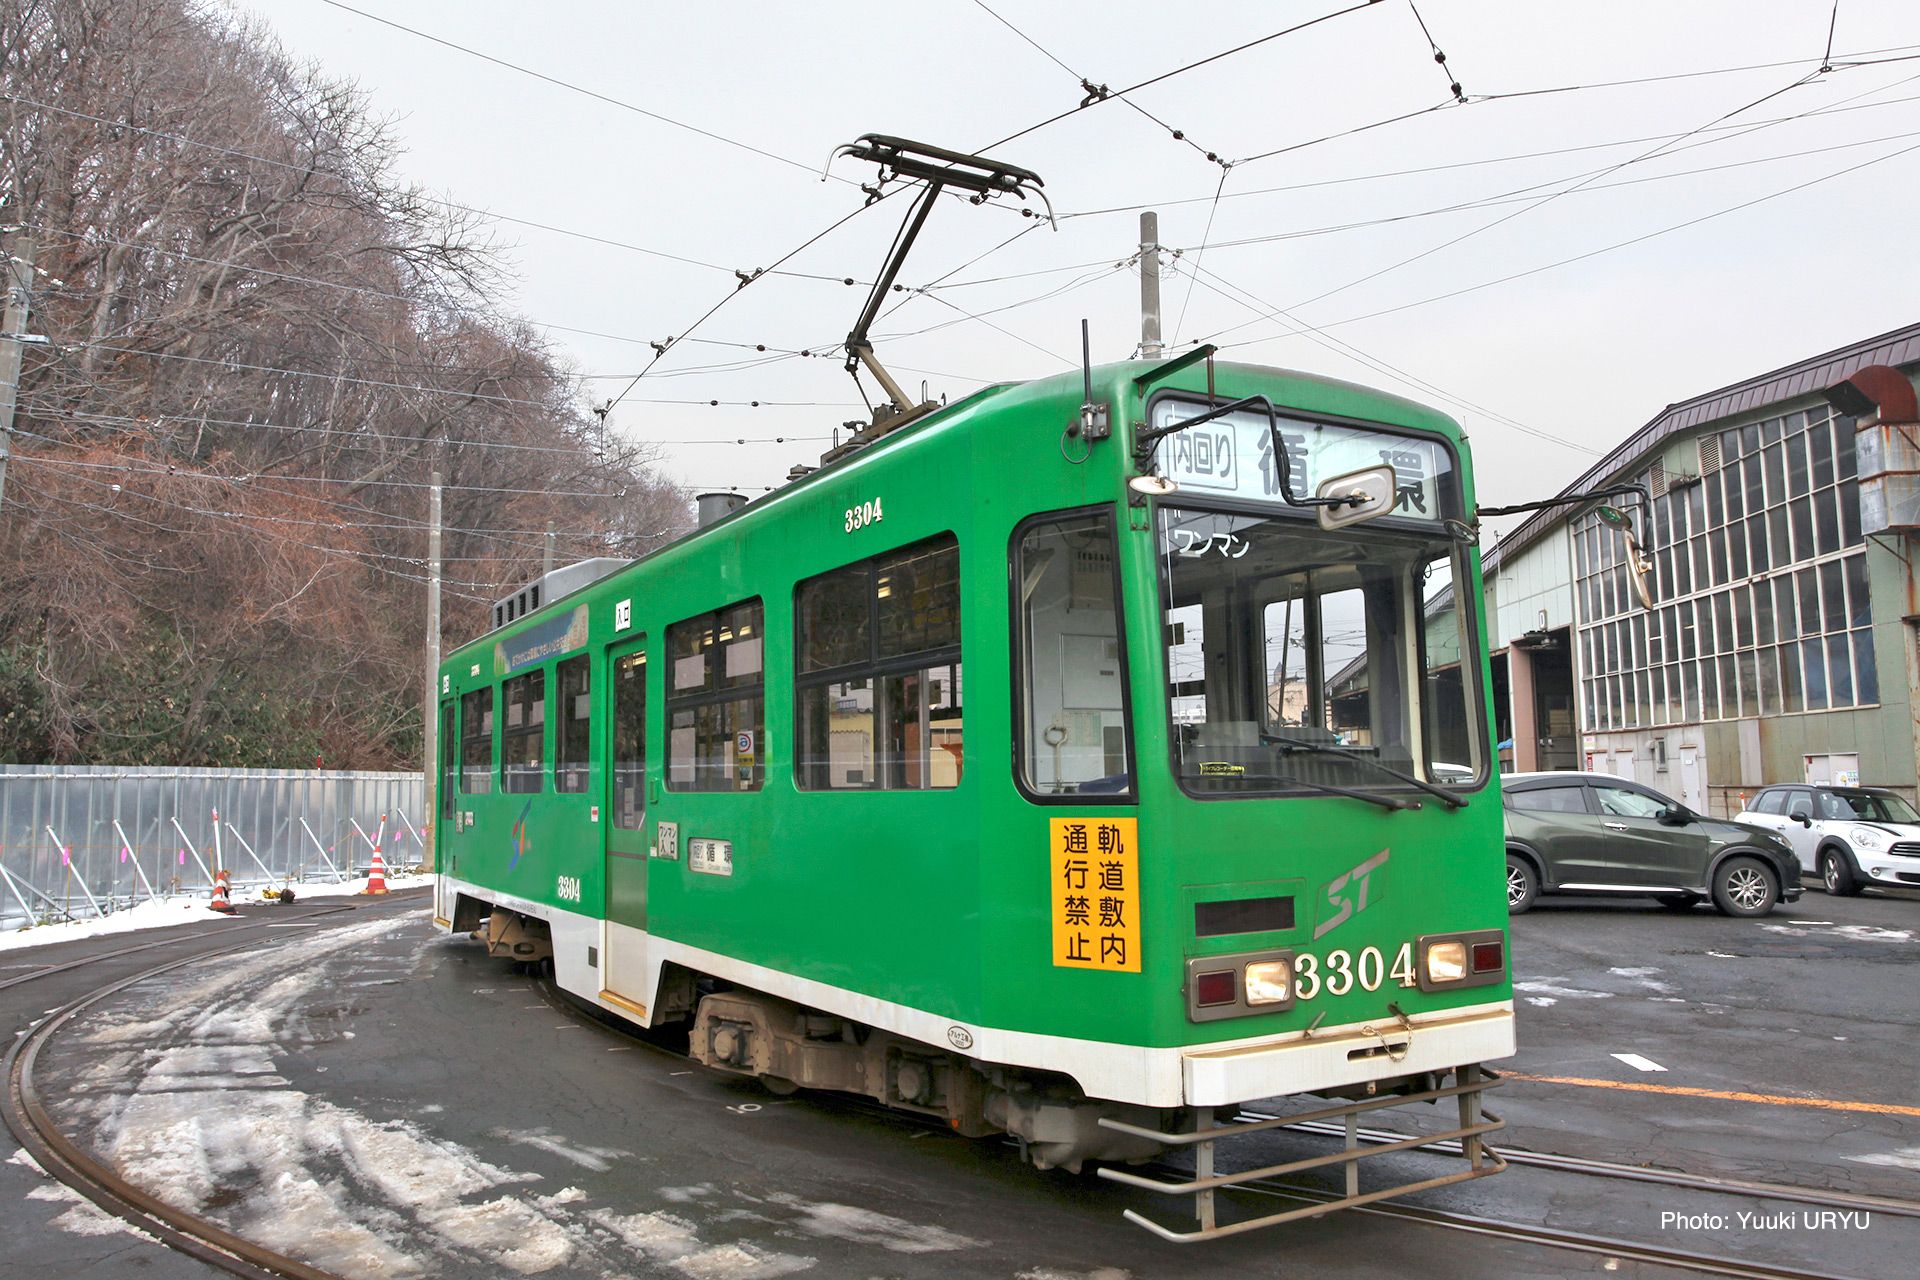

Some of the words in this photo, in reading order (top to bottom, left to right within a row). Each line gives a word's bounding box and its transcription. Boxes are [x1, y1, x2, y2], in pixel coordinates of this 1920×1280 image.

[1172, 429, 1231, 478] 内回り
[845, 496, 883, 533] 3304
[1174, 529, 1250, 558] ワンマン
[617, 606, 629, 625] 入口
[659, 825, 677, 839] ワンマン
[660, 839, 676, 854] 入口
[558, 875, 580, 902] 3304
[1063, 824, 1092, 962] 通行禁止
[1097, 824, 1126, 965] 軌道敷内
[1294, 941, 1417, 1000] 3304
